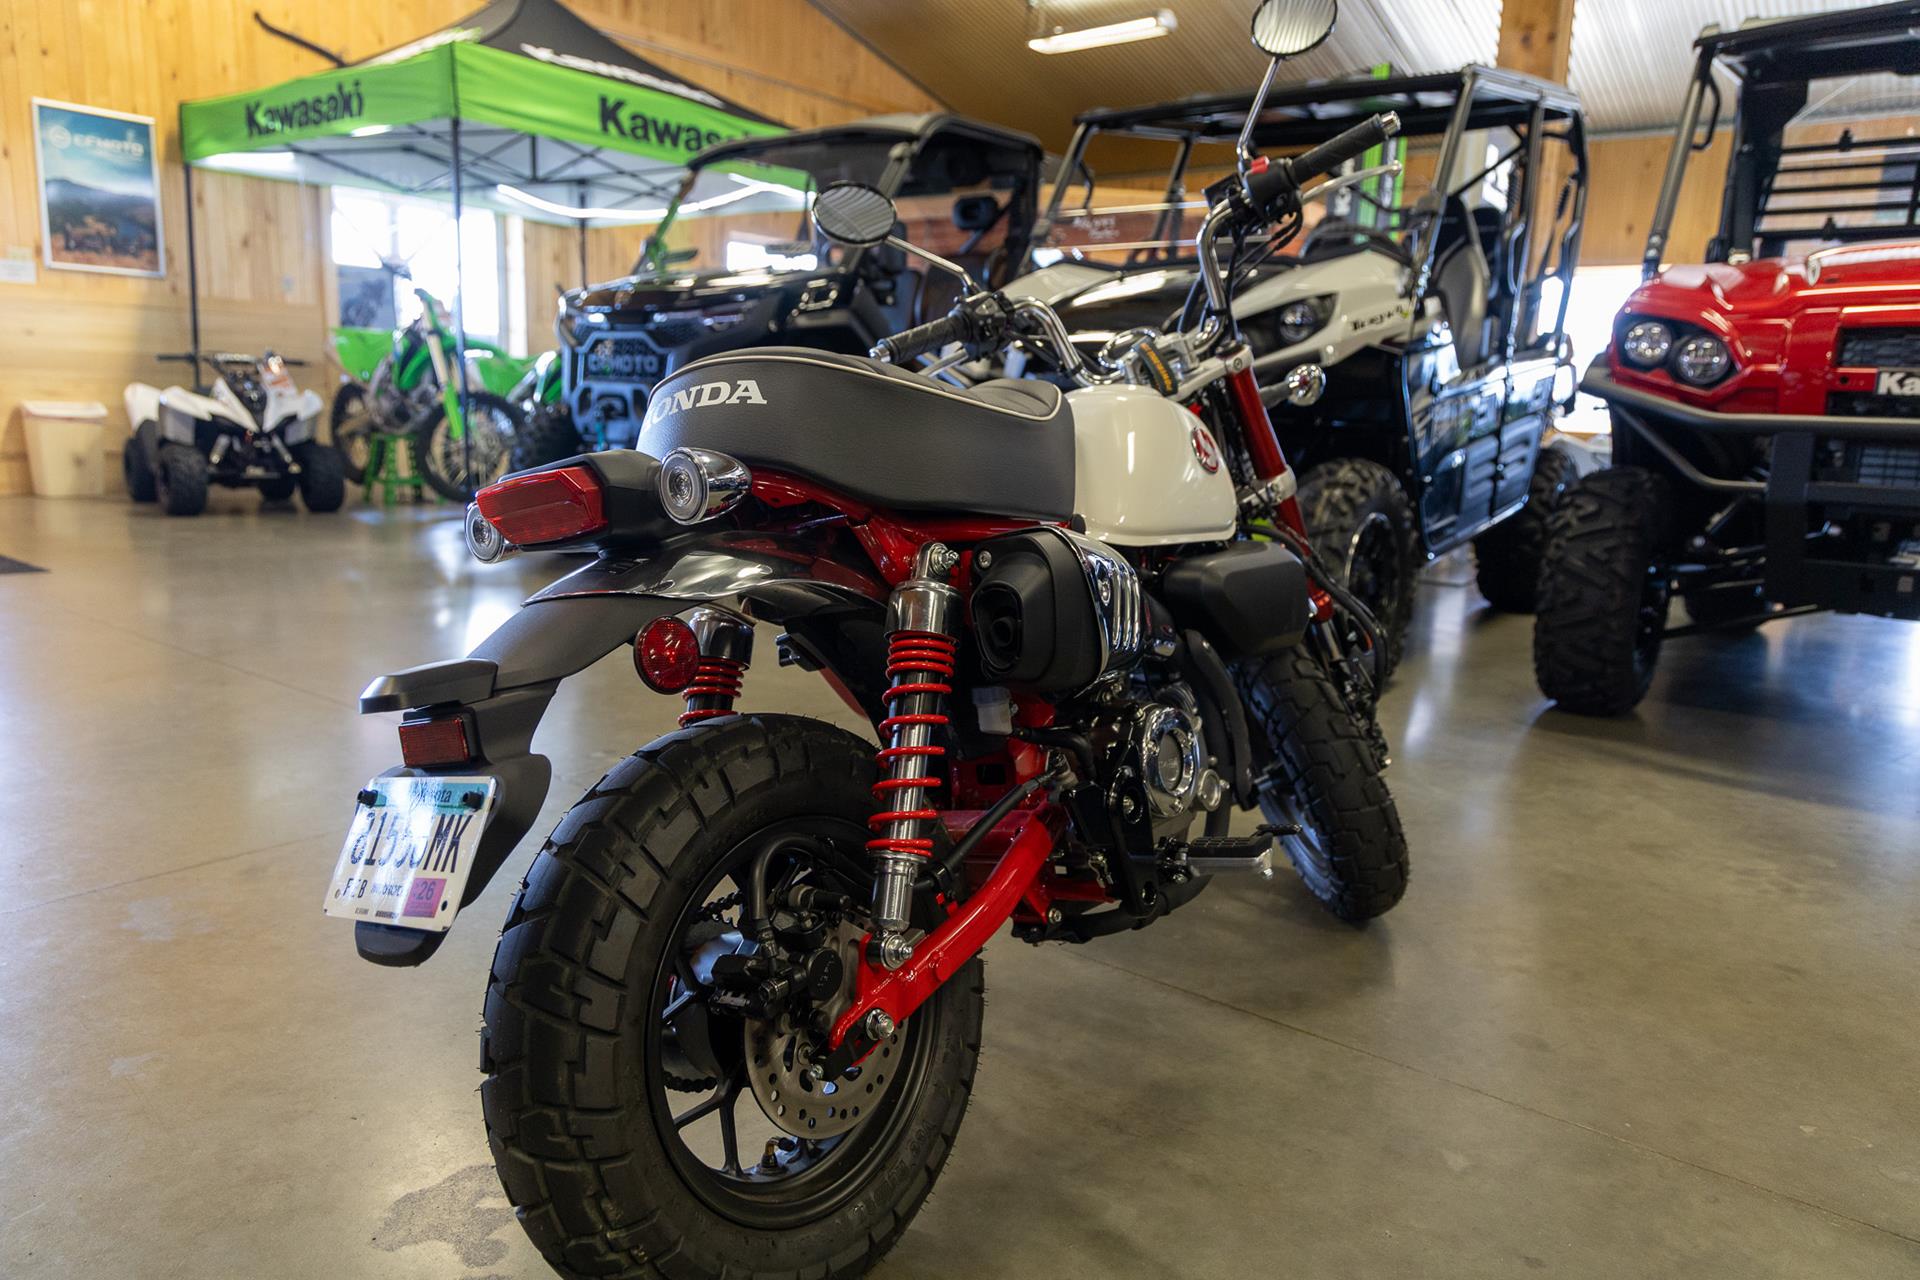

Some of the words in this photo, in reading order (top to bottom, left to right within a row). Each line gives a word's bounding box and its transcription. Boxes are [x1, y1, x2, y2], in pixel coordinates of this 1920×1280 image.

[246, 80, 363, 137] Kawasaki
[599, 94, 752, 153] Kawas
[342, 877, 368, 899] FB
